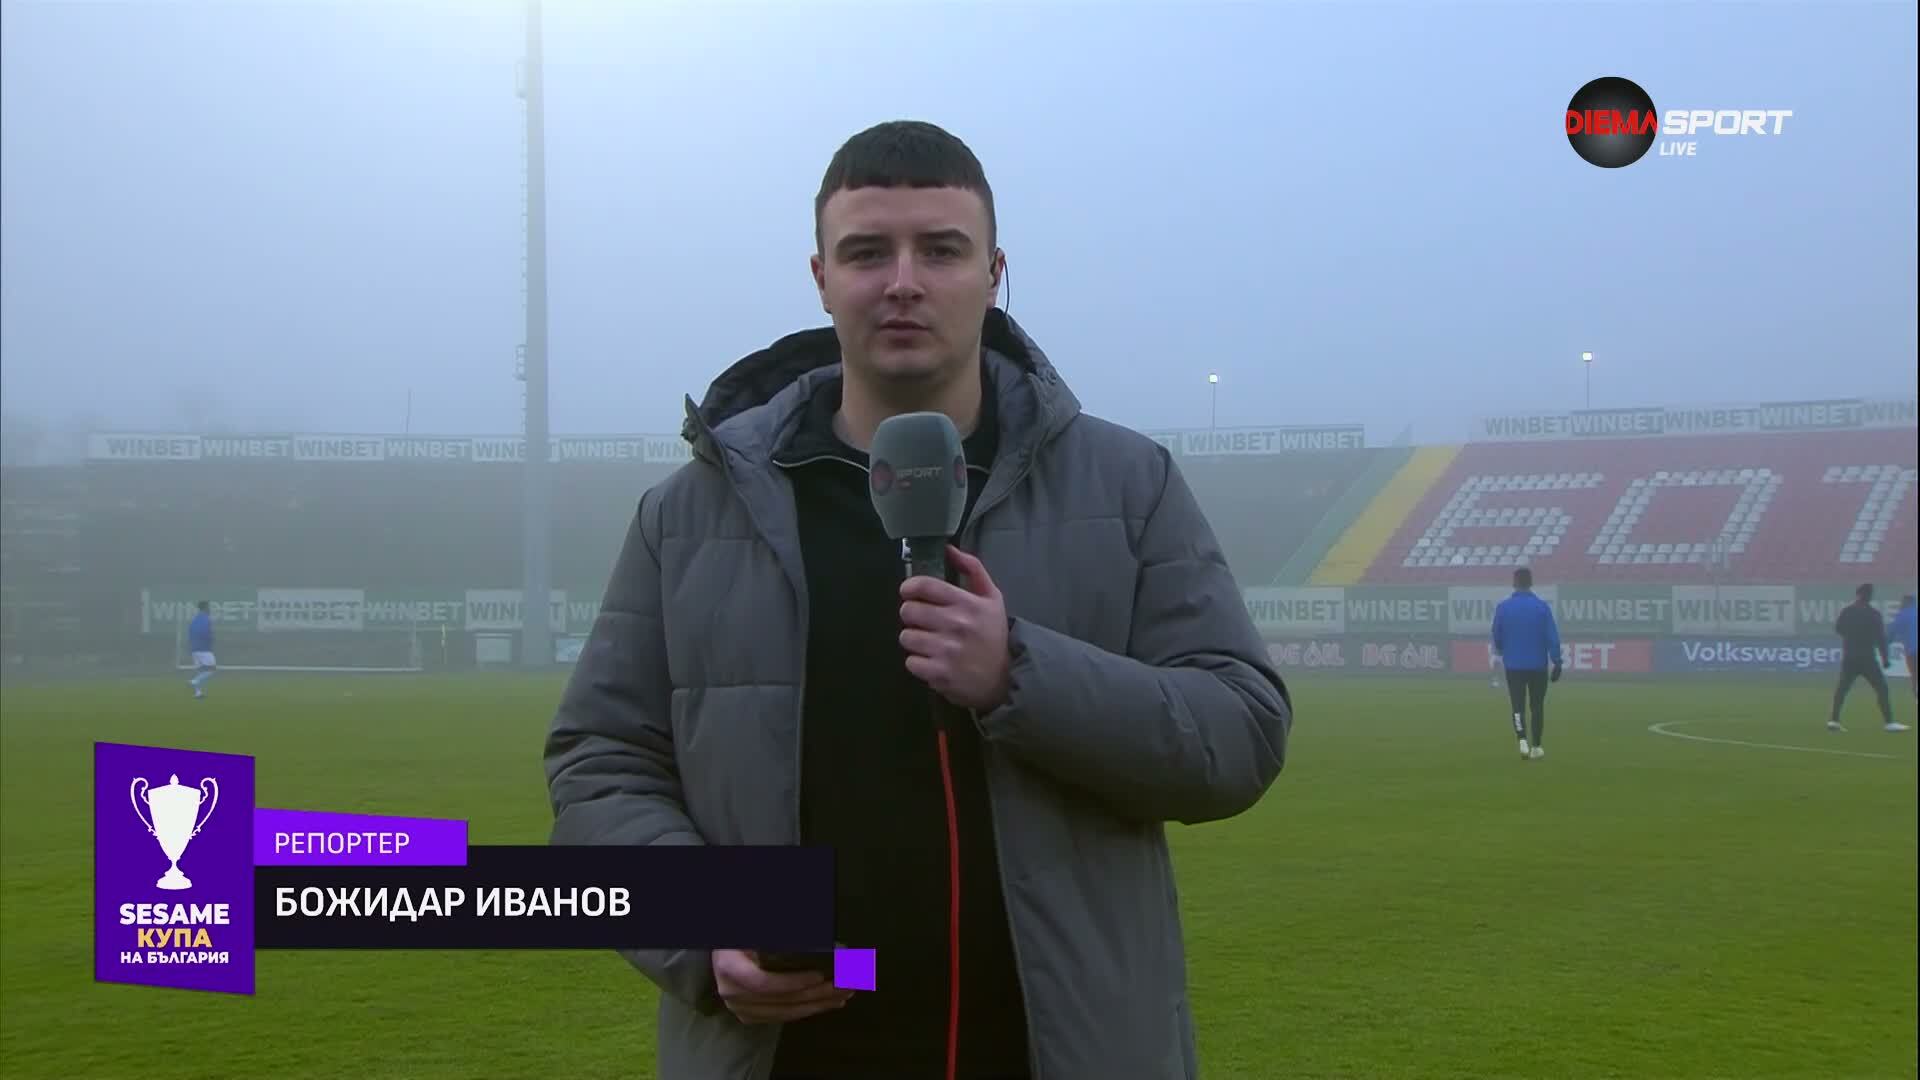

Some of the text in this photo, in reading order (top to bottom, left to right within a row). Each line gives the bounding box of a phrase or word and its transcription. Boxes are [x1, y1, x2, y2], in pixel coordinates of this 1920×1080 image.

[1487, 399, 1913, 435] WINBET WINBET WINBET WINBET WIN
[107, 439, 197, 457] WINBET
[202, 438, 288, 457] WINBET
[296, 439, 381, 457] WINBET
[387, 440, 466, 458] WINBET
[561, 441, 641, 458] WINBET
[647, 441, 690, 458] WIN
[1187, 432, 1275, 451] WINBET
[1281, 430, 1360, 449] WINBET
[261, 600, 360, 621] WINBET
[367, 600, 462, 621] WINBET
[1249, 600, 1340, 621] WINBET
[1348, 600, 1446, 621] WINBET
[1561, 599, 1671, 621] WINBET
[1678, 599, 1792, 622] WINBET
